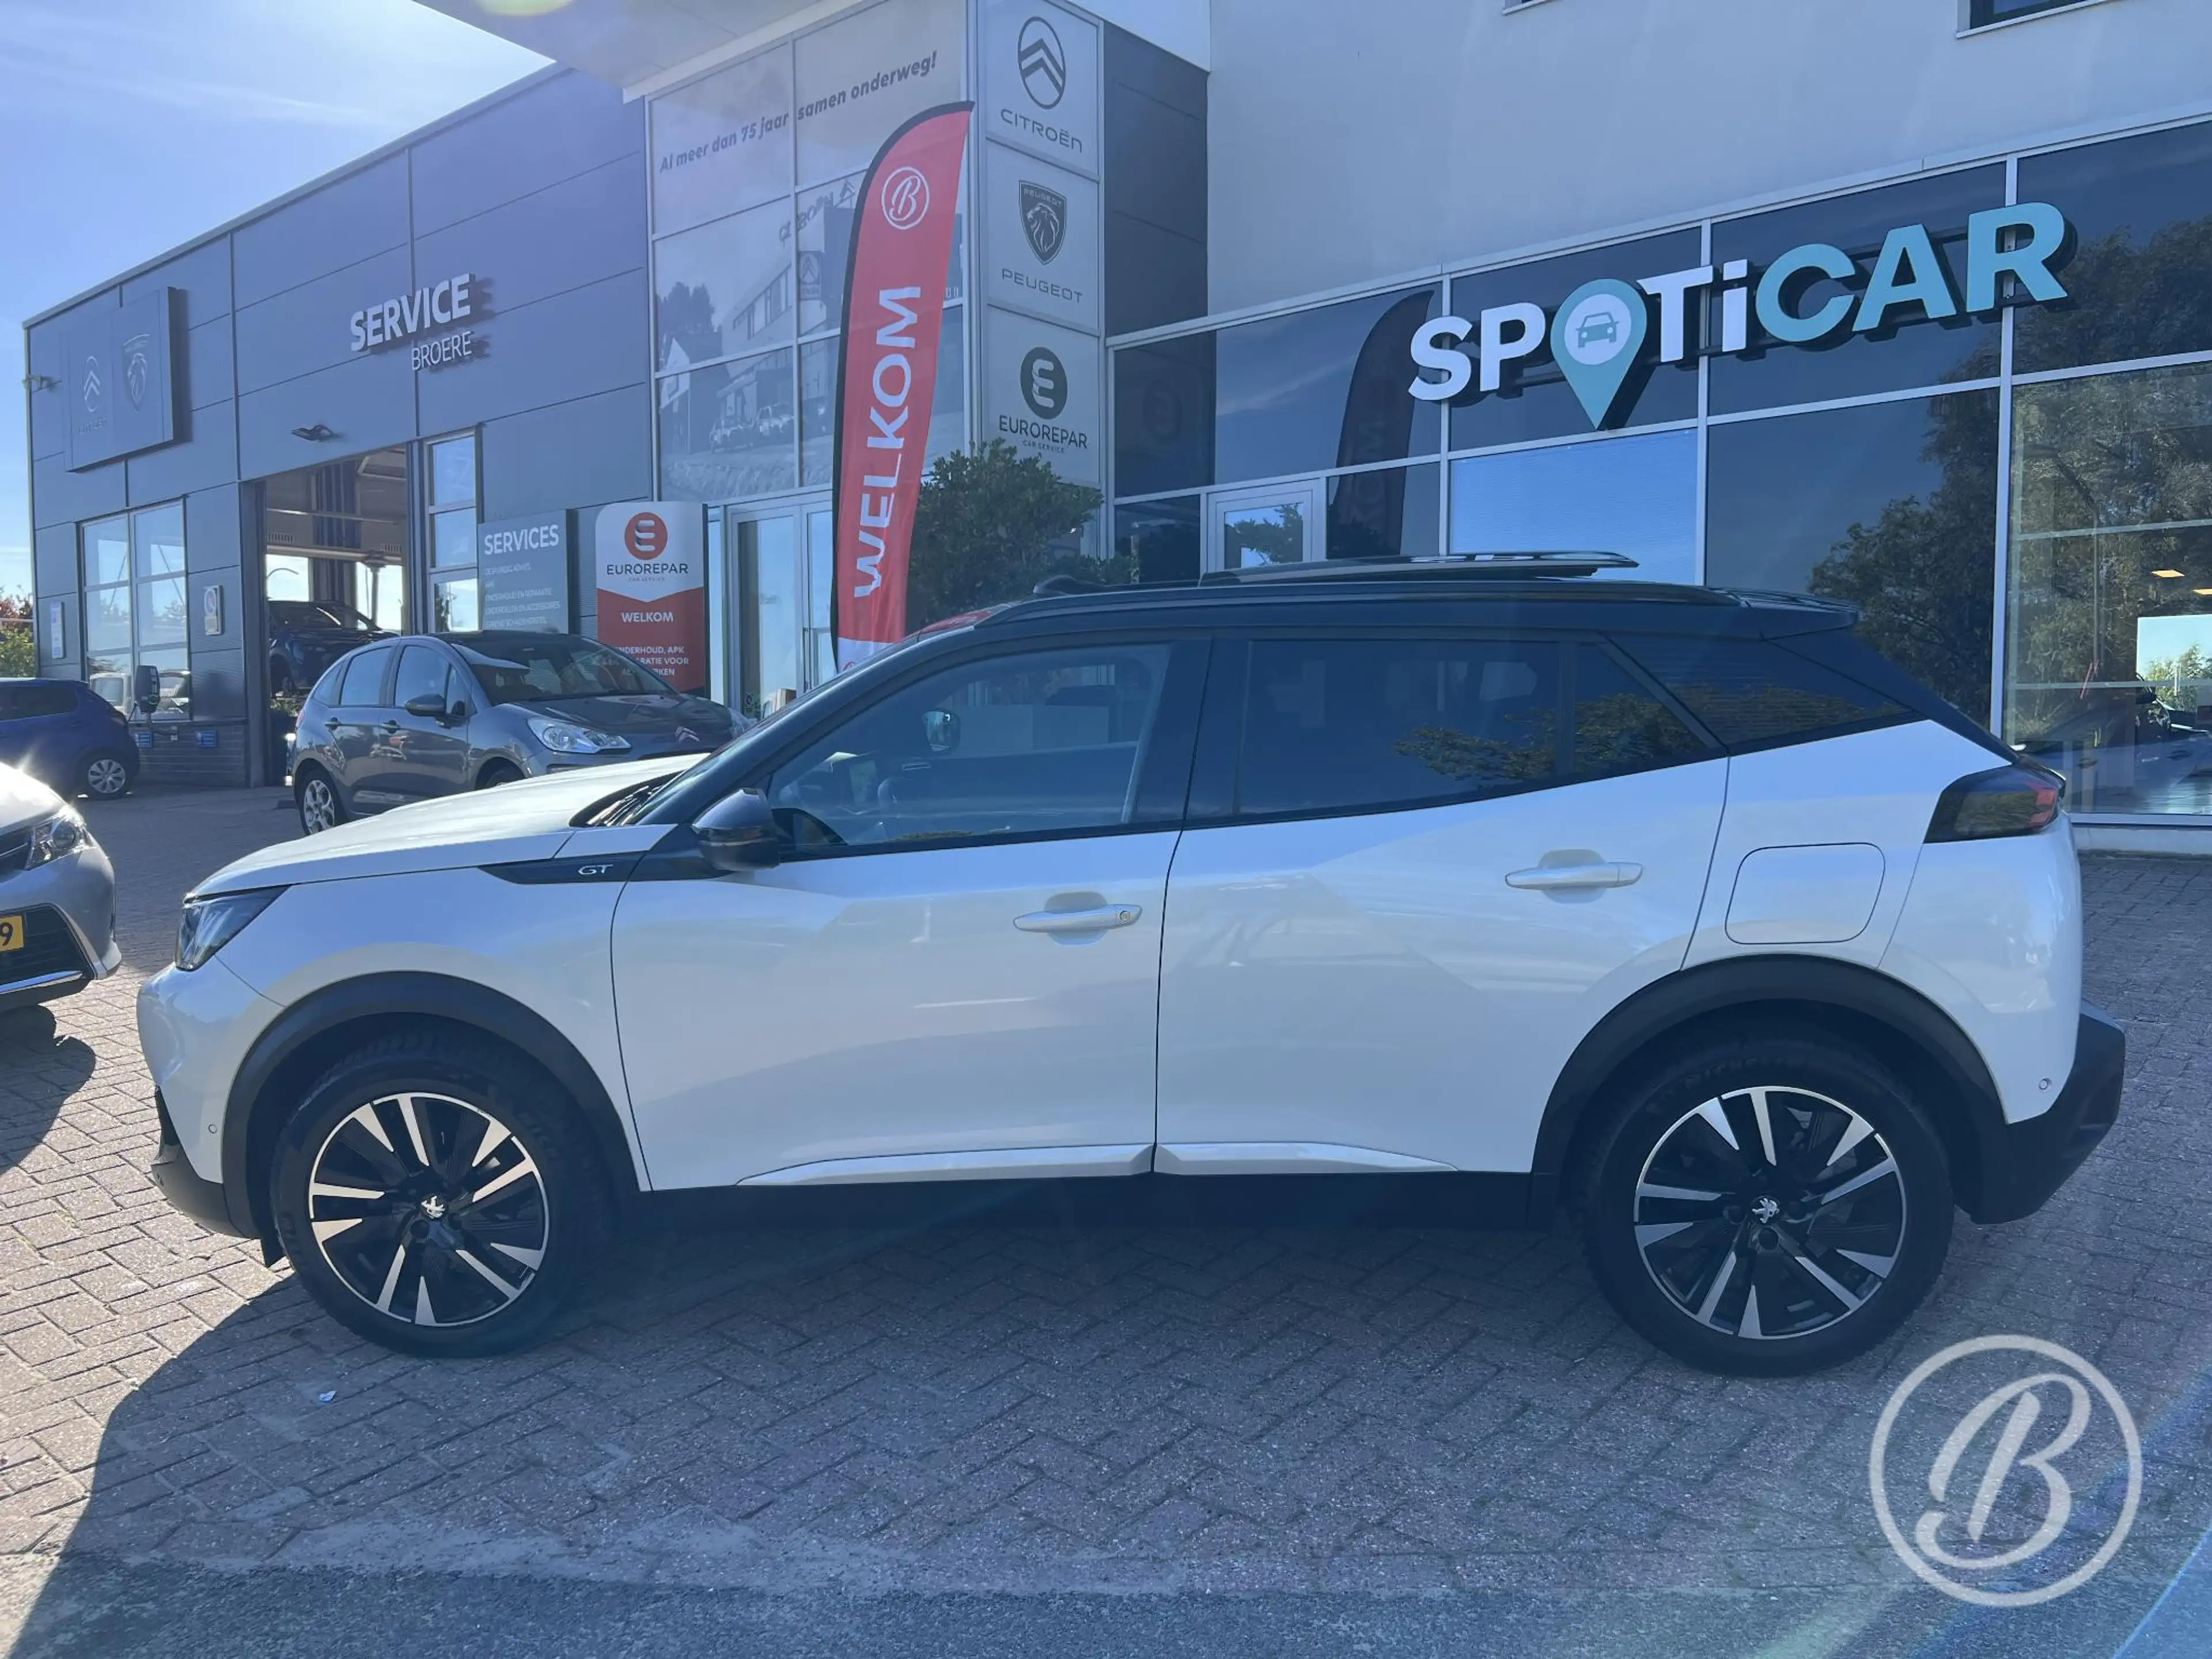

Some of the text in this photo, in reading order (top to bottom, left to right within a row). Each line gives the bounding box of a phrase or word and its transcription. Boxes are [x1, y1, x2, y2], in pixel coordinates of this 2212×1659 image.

[660, 50, 937, 173] Al meer dan 75 jaar samen onderweg!
[1002, 268, 1084, 303] PEUGEOT
[350, 273, 471, 351] SERVICE
[411, 331, 472, 371] BROERE
[854, 286, 921, 597] WELKOM
[999, 415, 1088, 449] EUROREPAR
[484, 524, 559, 555] SERVICES
[607, 563, 688, 575] EUROREPAR
[621, 612, 674, 623] WELKOM
[615, 646, 684, 654] NDERHOUD, APK
[578, 864, 613, 875] GT
